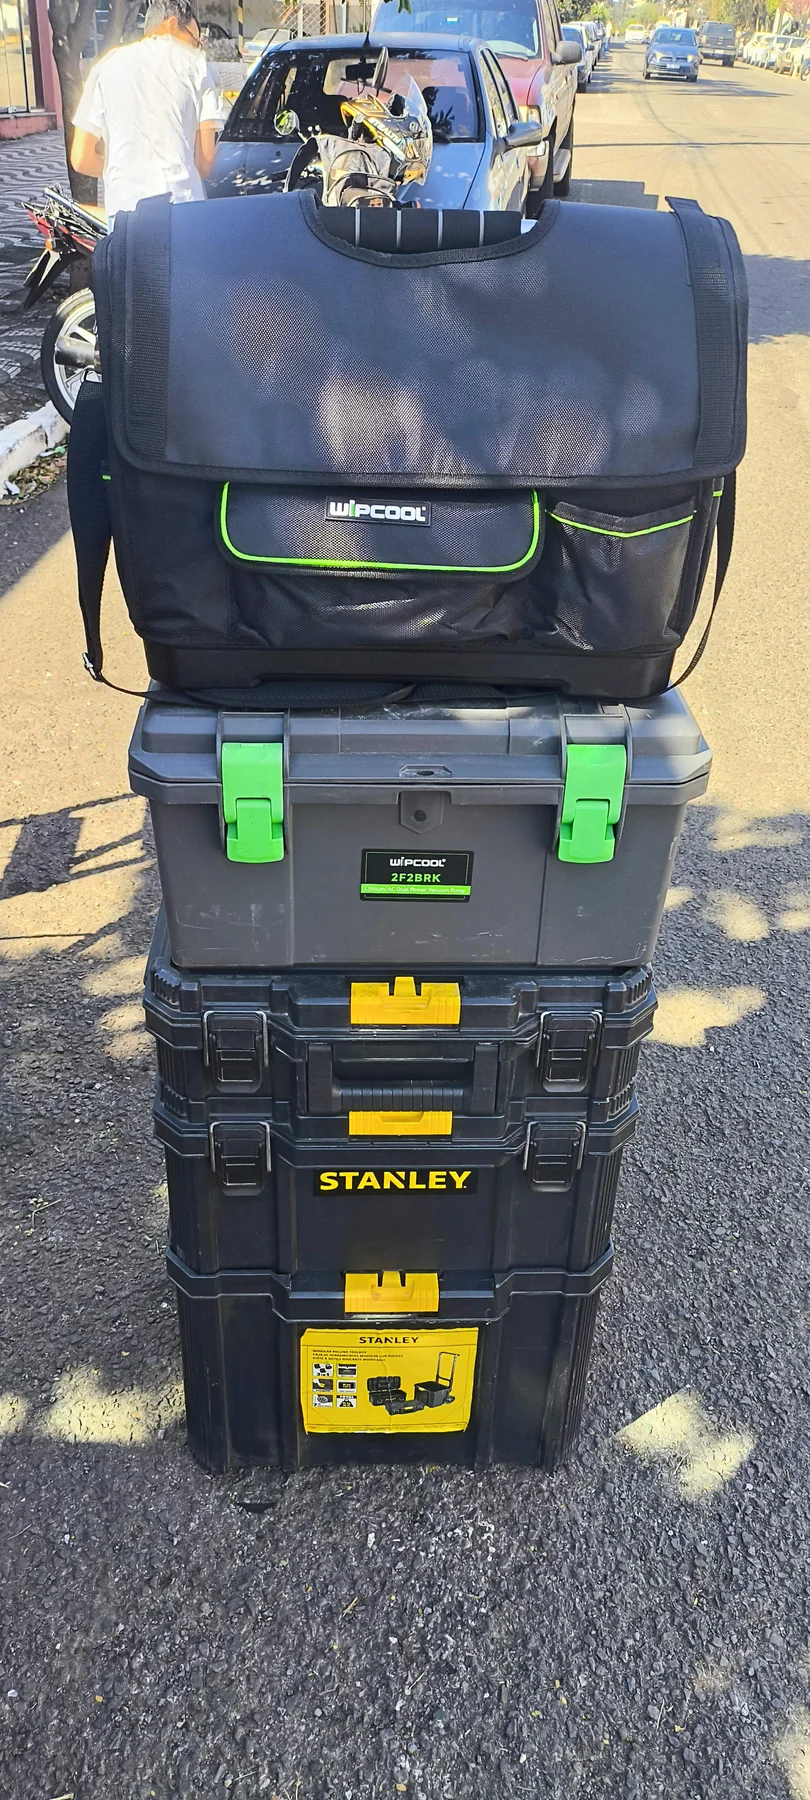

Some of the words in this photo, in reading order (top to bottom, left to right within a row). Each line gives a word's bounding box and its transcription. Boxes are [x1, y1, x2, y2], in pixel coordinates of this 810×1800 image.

[391, 873, 441, 883] 2F2BRK
[319, 1171, 472, 1191] STANLEY
[359, 1336, 419, 1344] STANLEY
